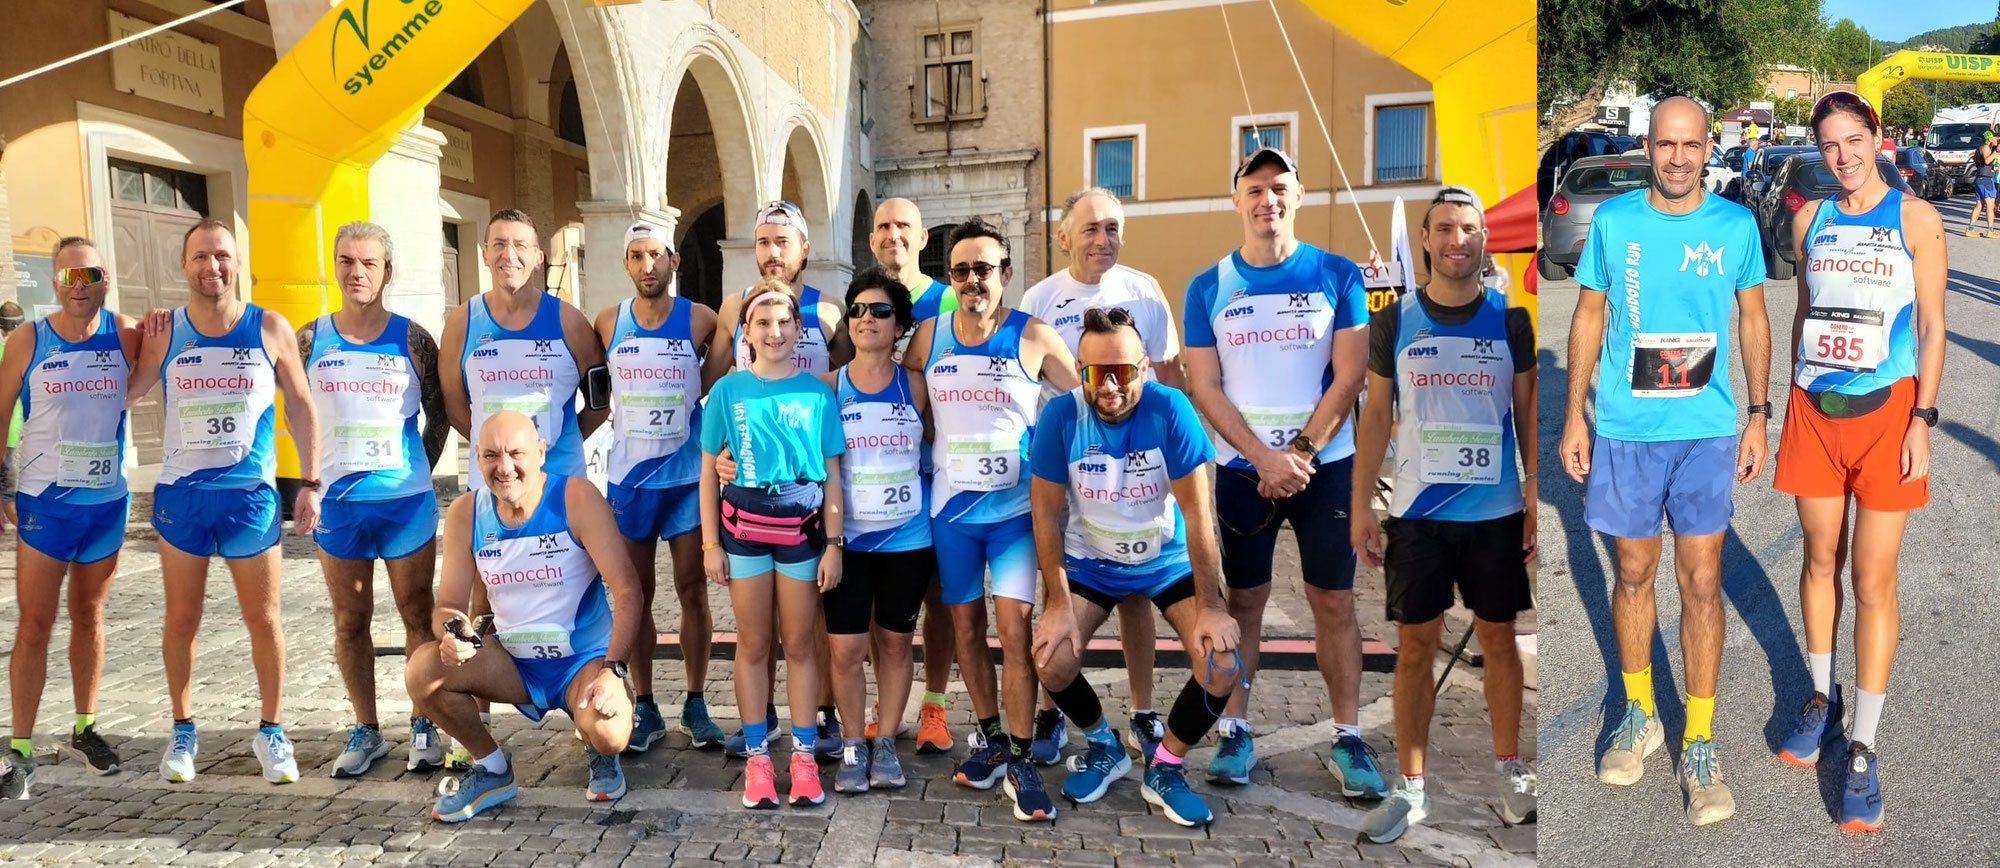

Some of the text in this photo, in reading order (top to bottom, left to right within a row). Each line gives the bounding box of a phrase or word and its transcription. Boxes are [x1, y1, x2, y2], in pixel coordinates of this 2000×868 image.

[344, 0, 443, 95] syemme
[178, 47, 216, 73] DELLA
[1946, 55, 1993, 71] UISP
[1814, 235, 1838, 244] AVIS
[1625, 241, 1642, 267] RUN
[1809, 257, 1893, 277] Ranocchi
[1854, 277, 1891, 288] software
[1225, 306, 1254, 318] AVIS
[1055, 314, 1080, 327] AVIS
[1225, 324, 1315, 347] Ranocchi
[473, 349, 499, 357] AVIS
[617, 346, 639, 354] AVIS
[1280, 343, 1315, 351] software
[1408, 347, 1438, 356] AVIS
[1817, 335, 1864, 362] 585
[43, 360, 69, 370] AVIS
[177, 356, 202, 365] AVIS
[318, 360, 345, 369] AVIS
[478, 366, 553, 383] Ranocchi
[617, 365, 686, 380] Ranocchi
[934, 365, 958, 374] AVIS
[1658, 363, 1691, 388] 11
[43, 376, 118, 395] Ranocchi
[176, 374, 254, 391] Ranocchi
[318, 379, 400, 394] Ranocchi
[525, 381, 553, 389] software
[659, 381, 685, 389] software
[1408, 370, 1496, 387] Ranocchi
[933, 388, 1011, 404] Ranocchi
[649, 409, 676, 426] 27
[207, 417, 236, 435] 36
[845, 432, 912, 450] anocch
[1270, 429, 1302, 447] 32
[366, 440, 391, 457] 31
[1458, 447, 1490, 467] 38
[88, 459, 112, 476] 28
[979, 457, 1009, 476] 33
[1079, 462, 1107, 473] AVIS
[884, 485, 911, 505] 26
[1077, 482, 1159, 503] Ranocchi
[479, 549, 502, 558] AVIS
[1115, 542, 1148, 555] 30
[484, 565, 563, 586] Ranocchi
[533, 581, 564, 589] software
[533, 645, 562, 659] 35
